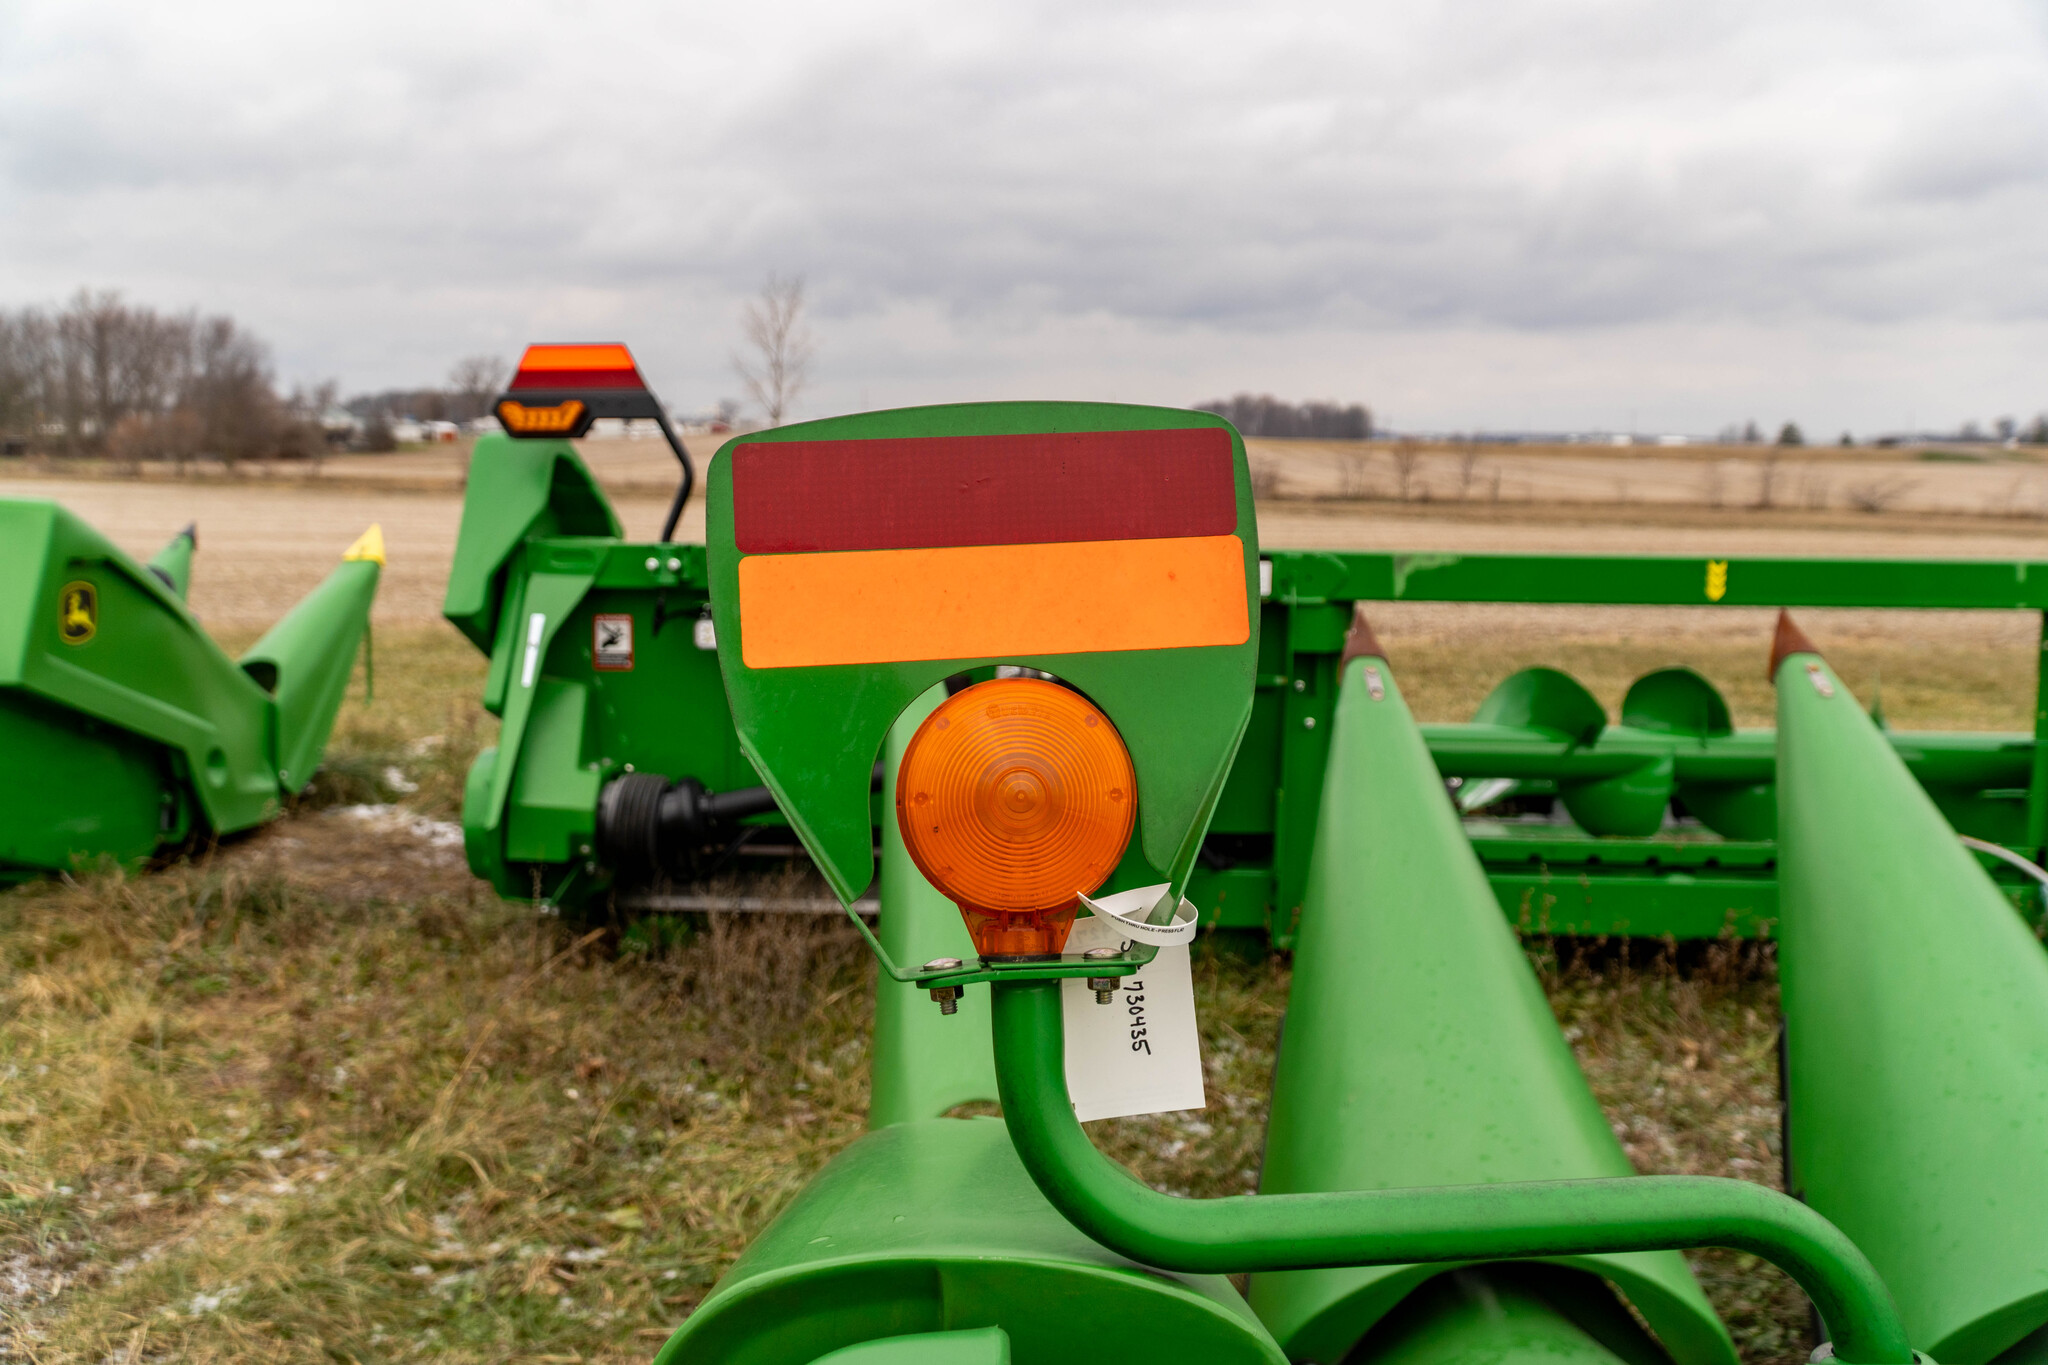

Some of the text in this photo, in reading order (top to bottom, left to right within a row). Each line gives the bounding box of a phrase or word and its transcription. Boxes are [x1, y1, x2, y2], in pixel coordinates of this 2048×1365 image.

[1111, 915, 1125, 924] PUSH
[1125, 921, 1140, 929] THRU
[1123, 981, 1152, 1056] 730435
